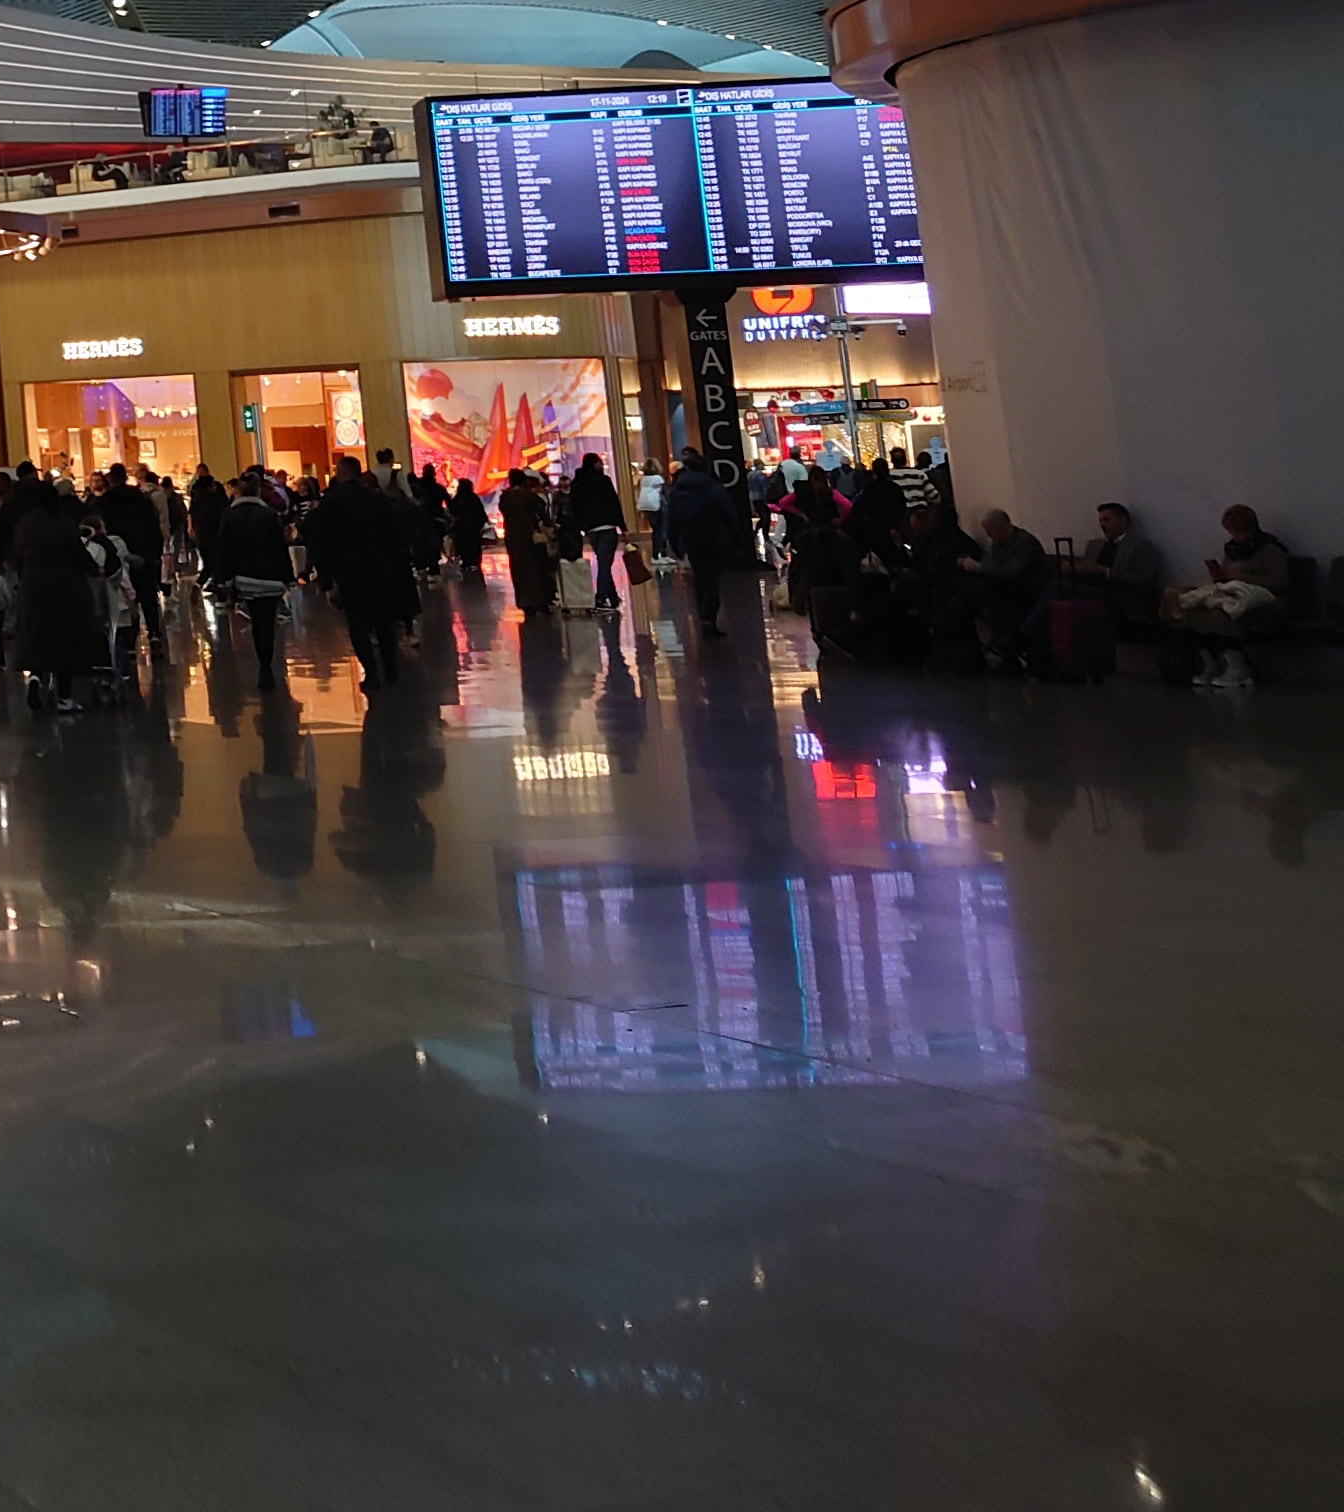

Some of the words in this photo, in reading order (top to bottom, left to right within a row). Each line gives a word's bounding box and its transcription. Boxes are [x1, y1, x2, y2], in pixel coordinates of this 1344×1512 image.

[460, 103, 491, 113] HATLAR
[590, 96, 630, 106] 17-11-2024
[647, 94, 668, 104] 12:19
[720, 90, 751, 99] HATLAR
[690, 330, 727, 341] GATES
[701, 347, 725, 375] A
[705, 384, 726, 413] B
[708, 421, 733, 450] C
[713, 459, 740, 487] D
